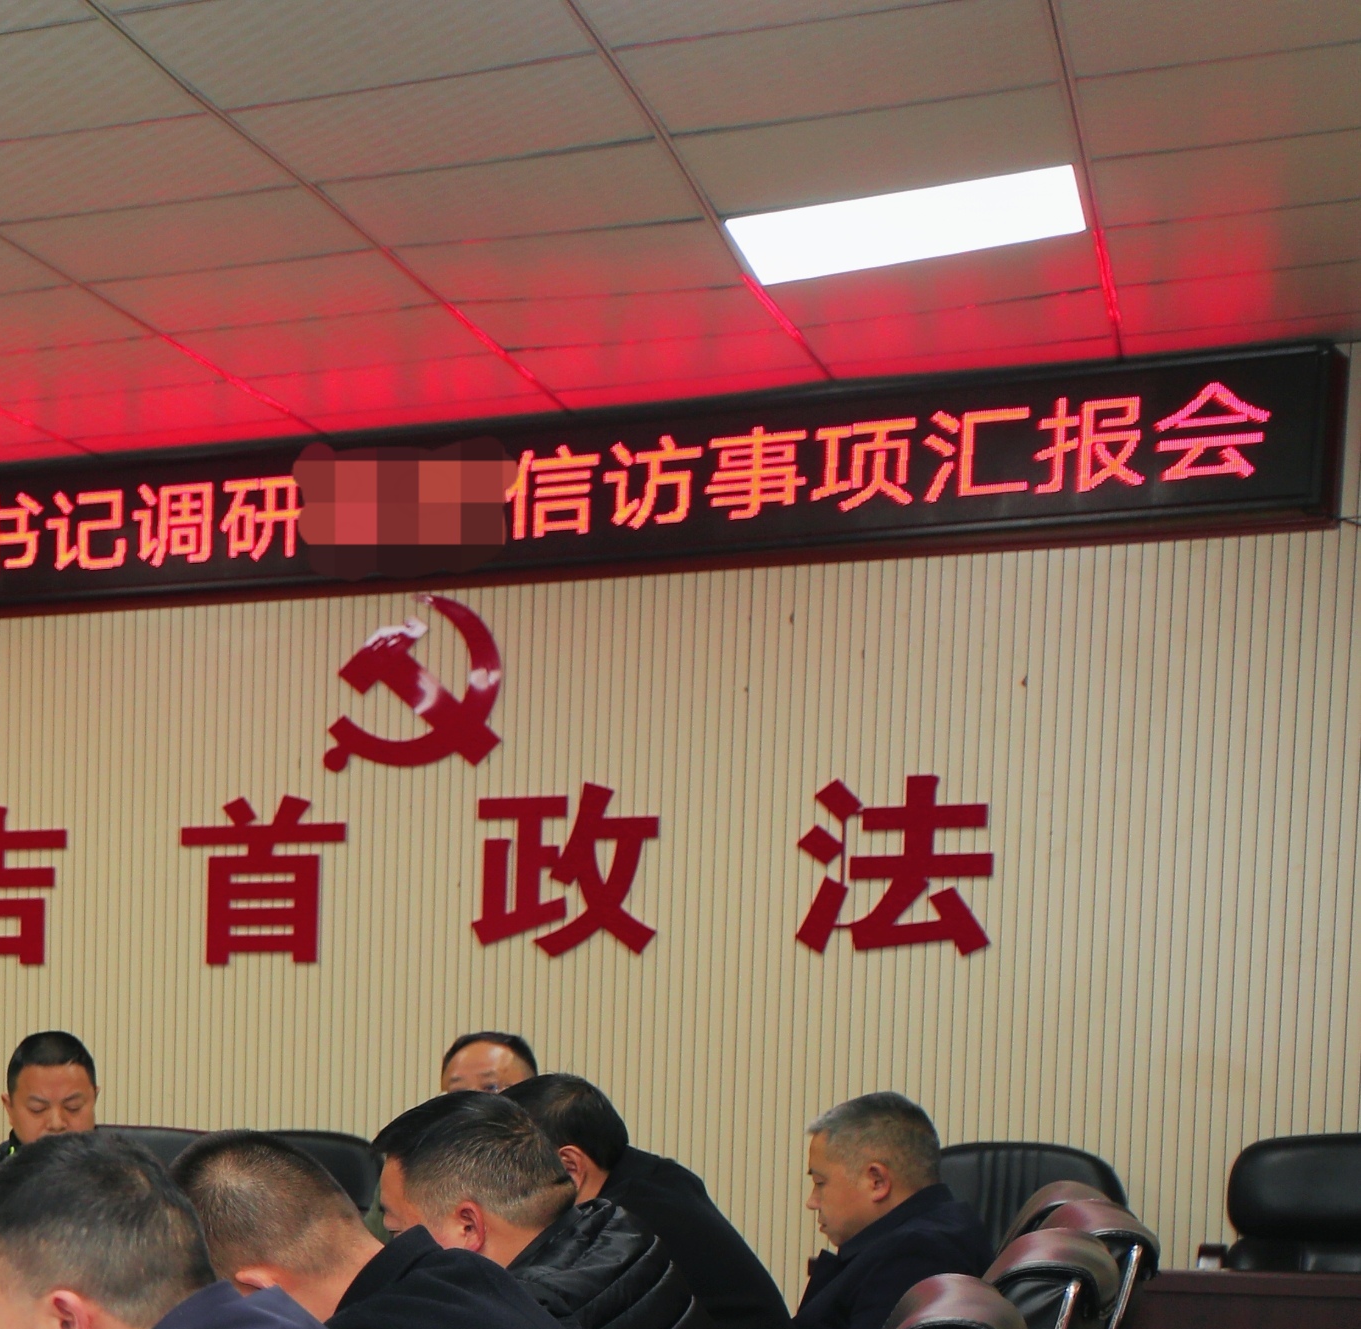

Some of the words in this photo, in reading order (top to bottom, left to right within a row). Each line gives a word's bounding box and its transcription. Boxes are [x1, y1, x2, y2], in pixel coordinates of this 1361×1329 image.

[505, 380, 1272, 542] 信访事项汇报会
